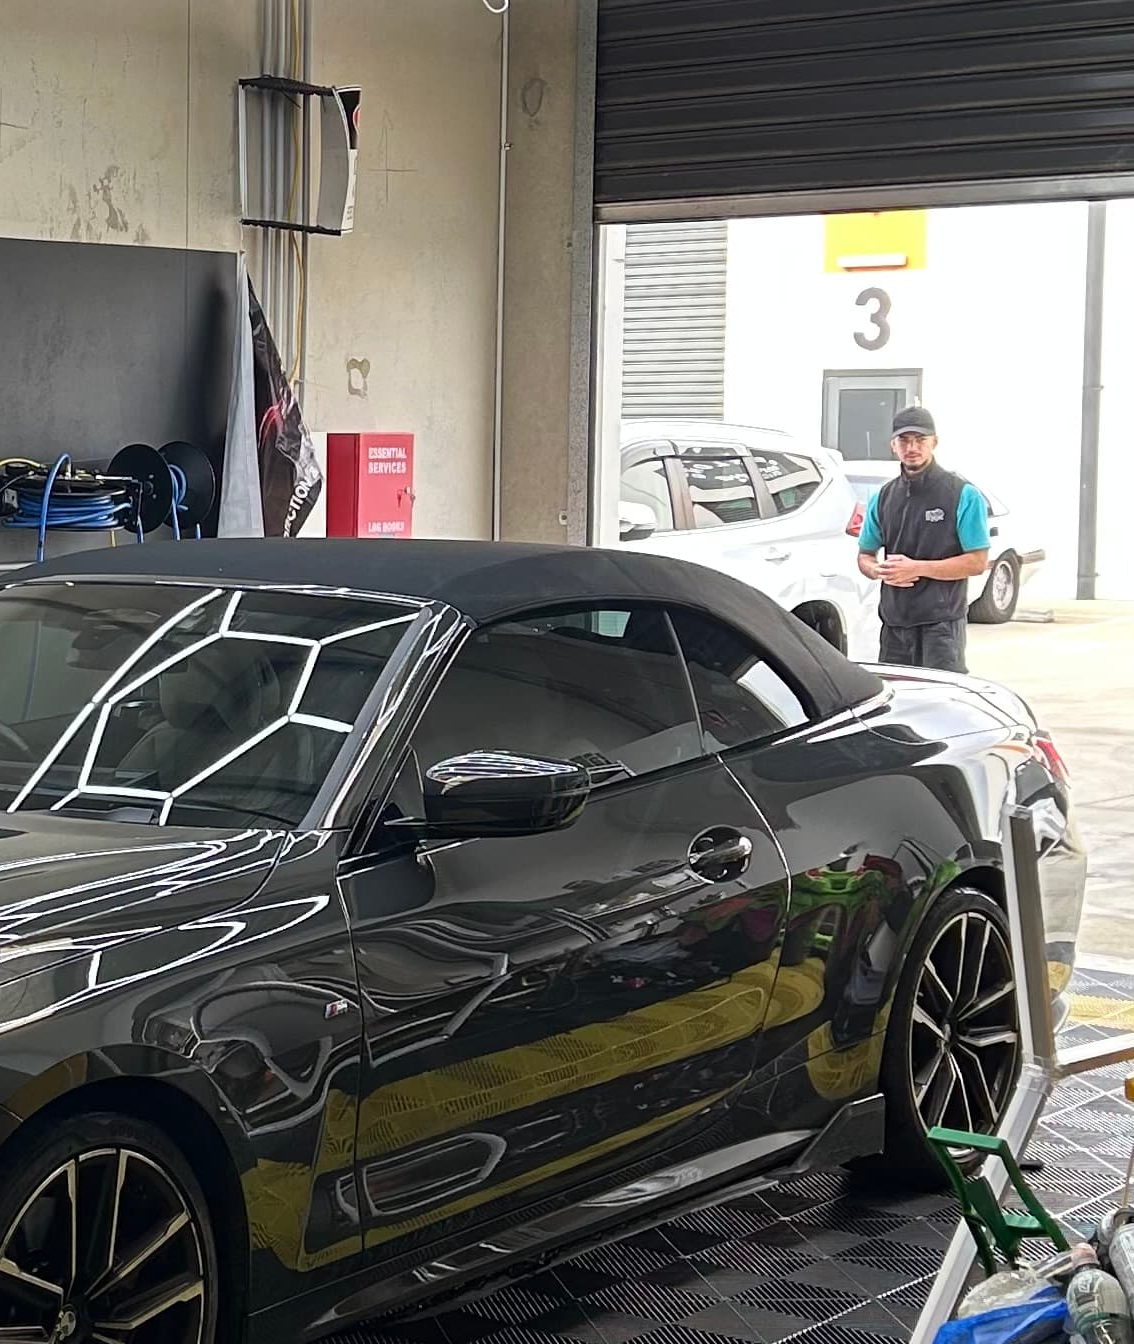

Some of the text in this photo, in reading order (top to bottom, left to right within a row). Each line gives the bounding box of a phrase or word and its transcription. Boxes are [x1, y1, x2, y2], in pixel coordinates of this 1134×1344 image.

[853, 287, 892, 351] 3
[368, 447, 407, 458] ESSENTIAL
[368, 461, 406, 474] SERVICES
[368, 521, 381, 533] LOG
